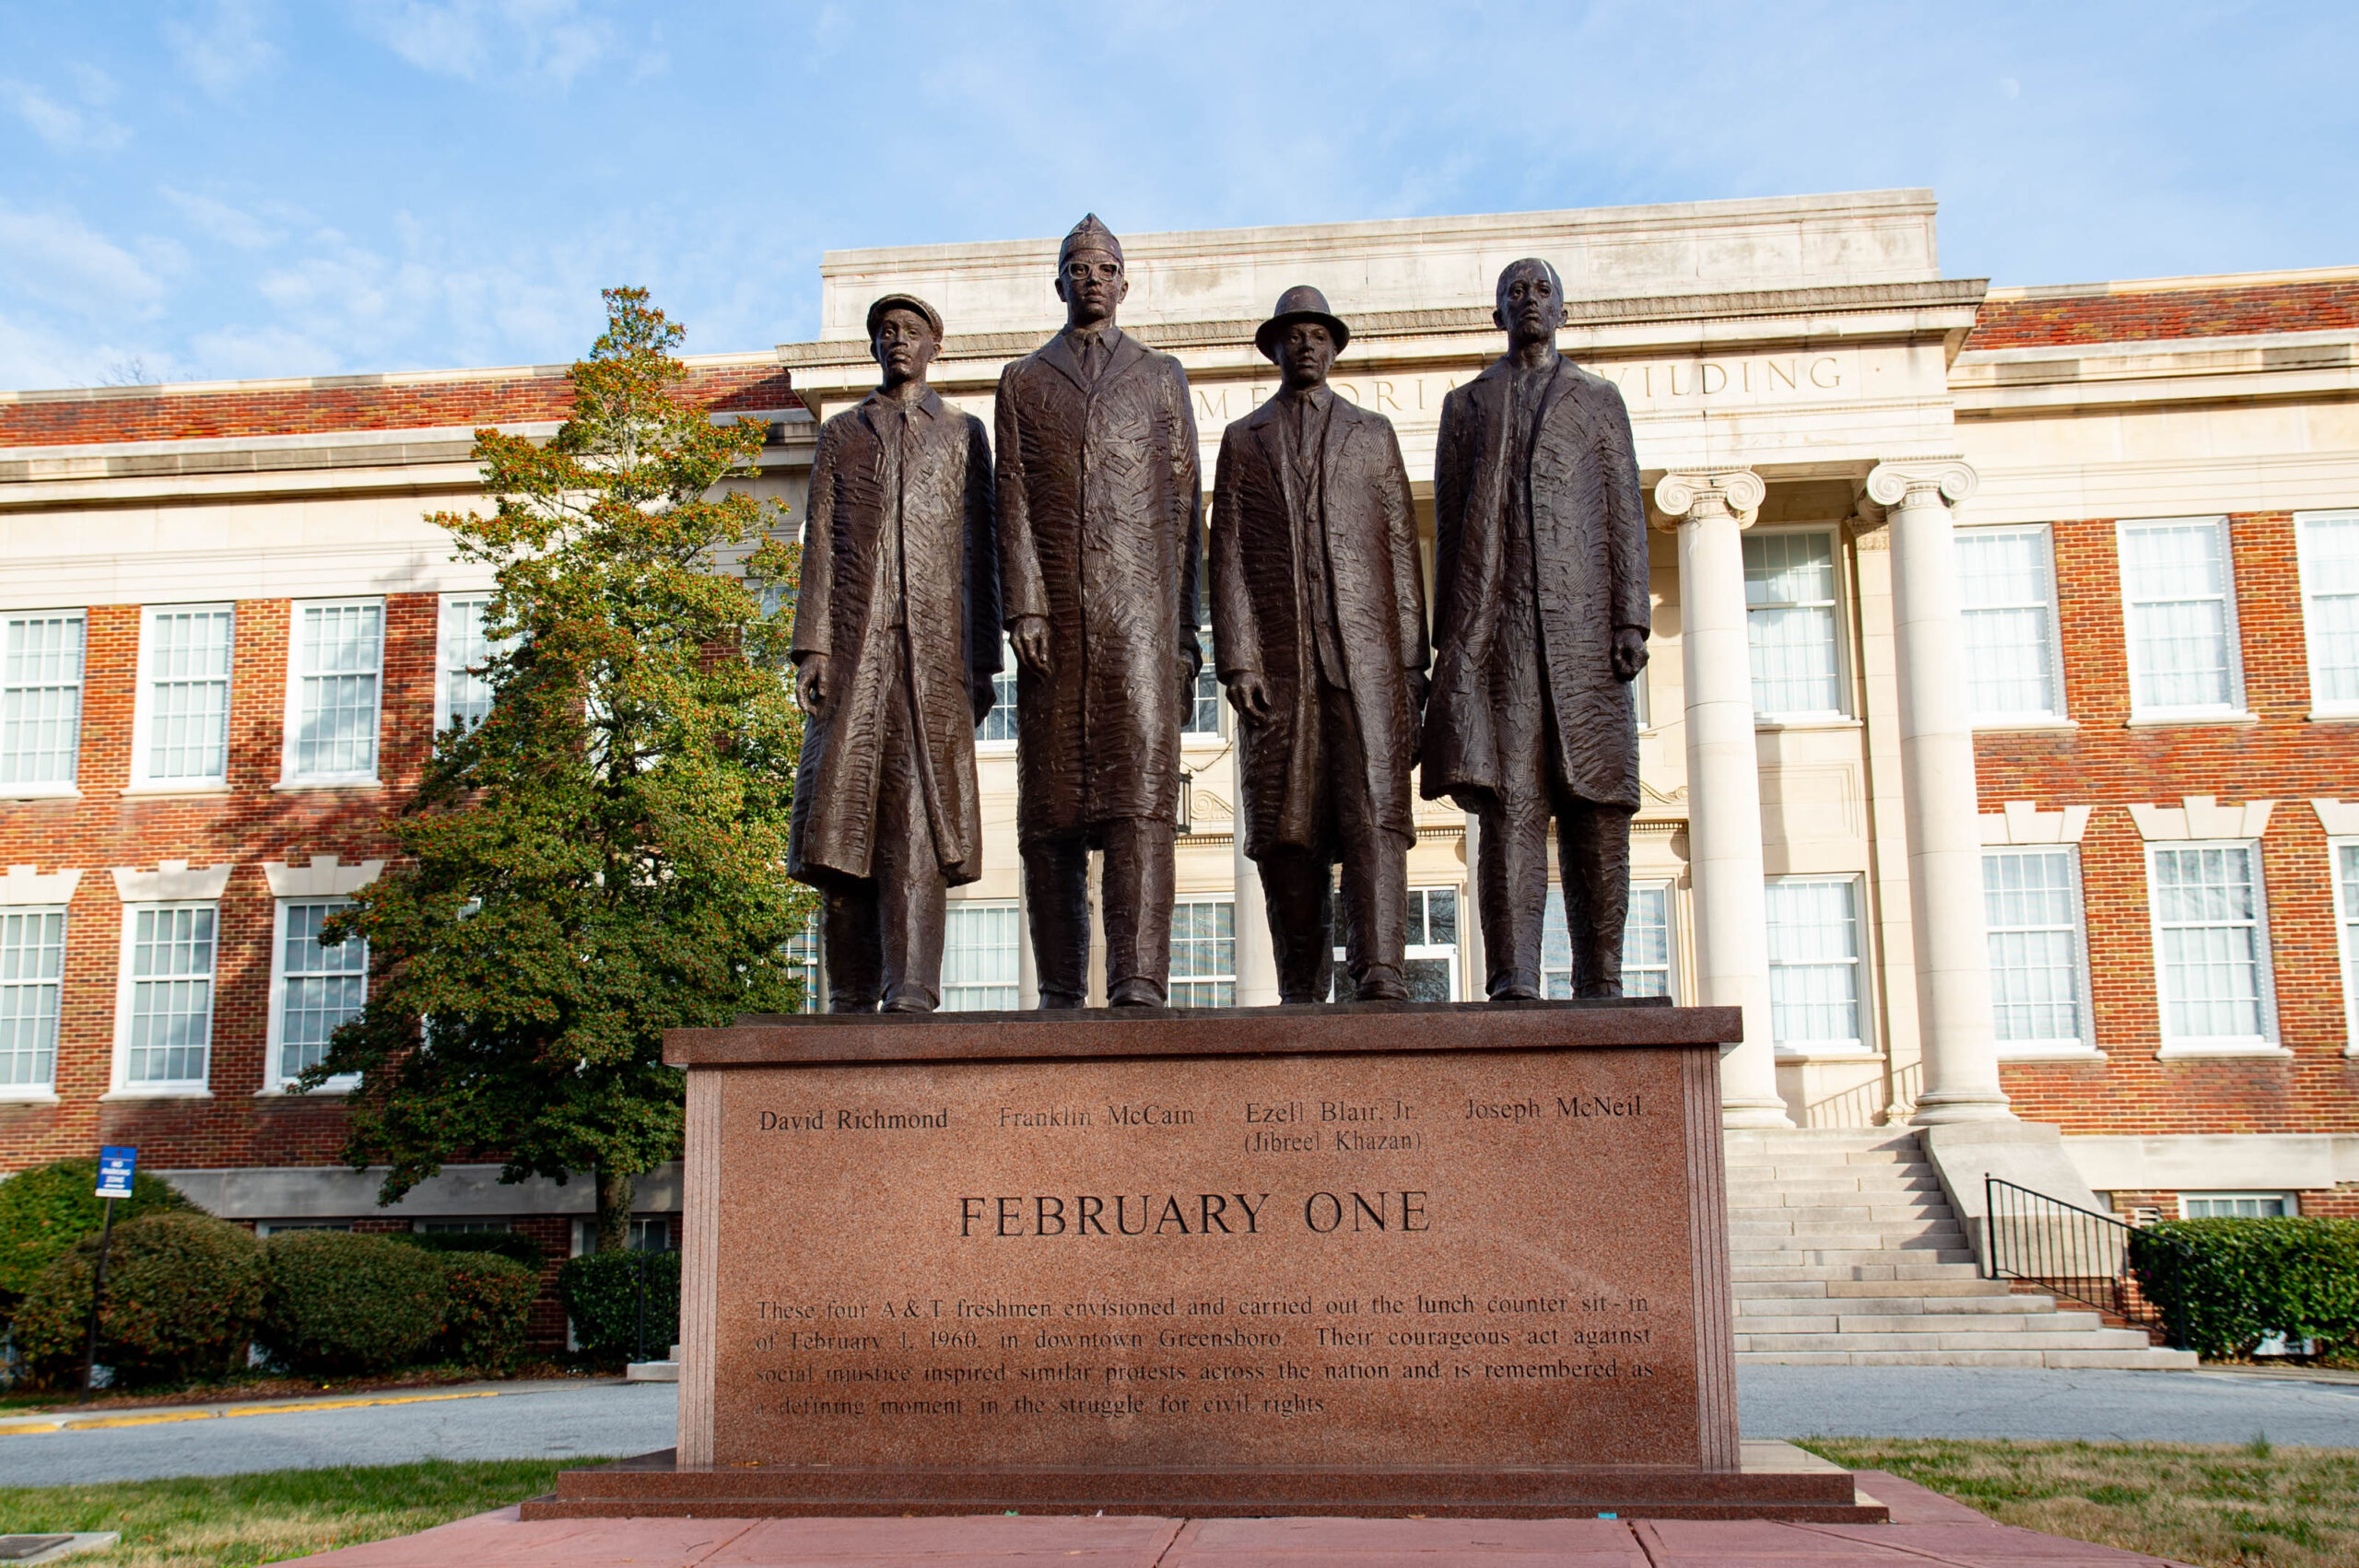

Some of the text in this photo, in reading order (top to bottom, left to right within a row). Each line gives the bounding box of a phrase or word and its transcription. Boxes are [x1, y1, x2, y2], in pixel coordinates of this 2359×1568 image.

[760, 1107, 948, 1130] David Richmond
[999, 1105, 1194, 1127] Franklin McCain
[1246, 1102, 1304, 1123] Ezell
[1465, 1095, 1641, 1123] Joseph McNeil
[1244, 1130, 1421, 1154] (Jibreel Khazan)
[959, 1191, 1431, 1236] FEBRUARY ONE
[757, 1300, 815, 1319] These
[827, 1300, 869, 1319] four
[880, 1300, 896, 1318] A
[903, 1299, 921, 1318] &
[929, 1299, 944, 1317] T
[957, 1298, 1051, 1317] freshmen
[1063, 1297, 1175, 1316] envisioned
[1188, 1297, 1225, 1316] and
[1238, 1296, 1312, 1315] carried
[1326, 1298, 1358, 1315] out
[1371, 1295, 1403, 1315] the
[1417, 1294, 1474, 1314] lunch
[1487, 1296, 1567, 1313] counter
[756, 1331, 778, 1351] of
[791, 1331, 883, 1352] February
[1001, 1331, 1018, 1349] in
[1035, 1329, 1143, 1349] downtown
[1315, 1328, 1374, 1346] Their
[1388, 1329, 1510, 1350] courageous
[1527, 1328, 1559, 1345] act
[1574, 1325, 1650, 1348] against
[756, 1359, 1654, 1387] social injustice inspired similar protests across the nation and is remembered as
[779, 1396, 865, 1419] defining
[881, 1398, 961, 1415] moment
[980, 1395, 998, 1414] in
[1015, 1395, 1045, 1414] the
[1060, 1394, 1144, 1419] struggle
[1160, 1394, 1190, 1414] for
[1203, 1394, 1250, 1413] civil
